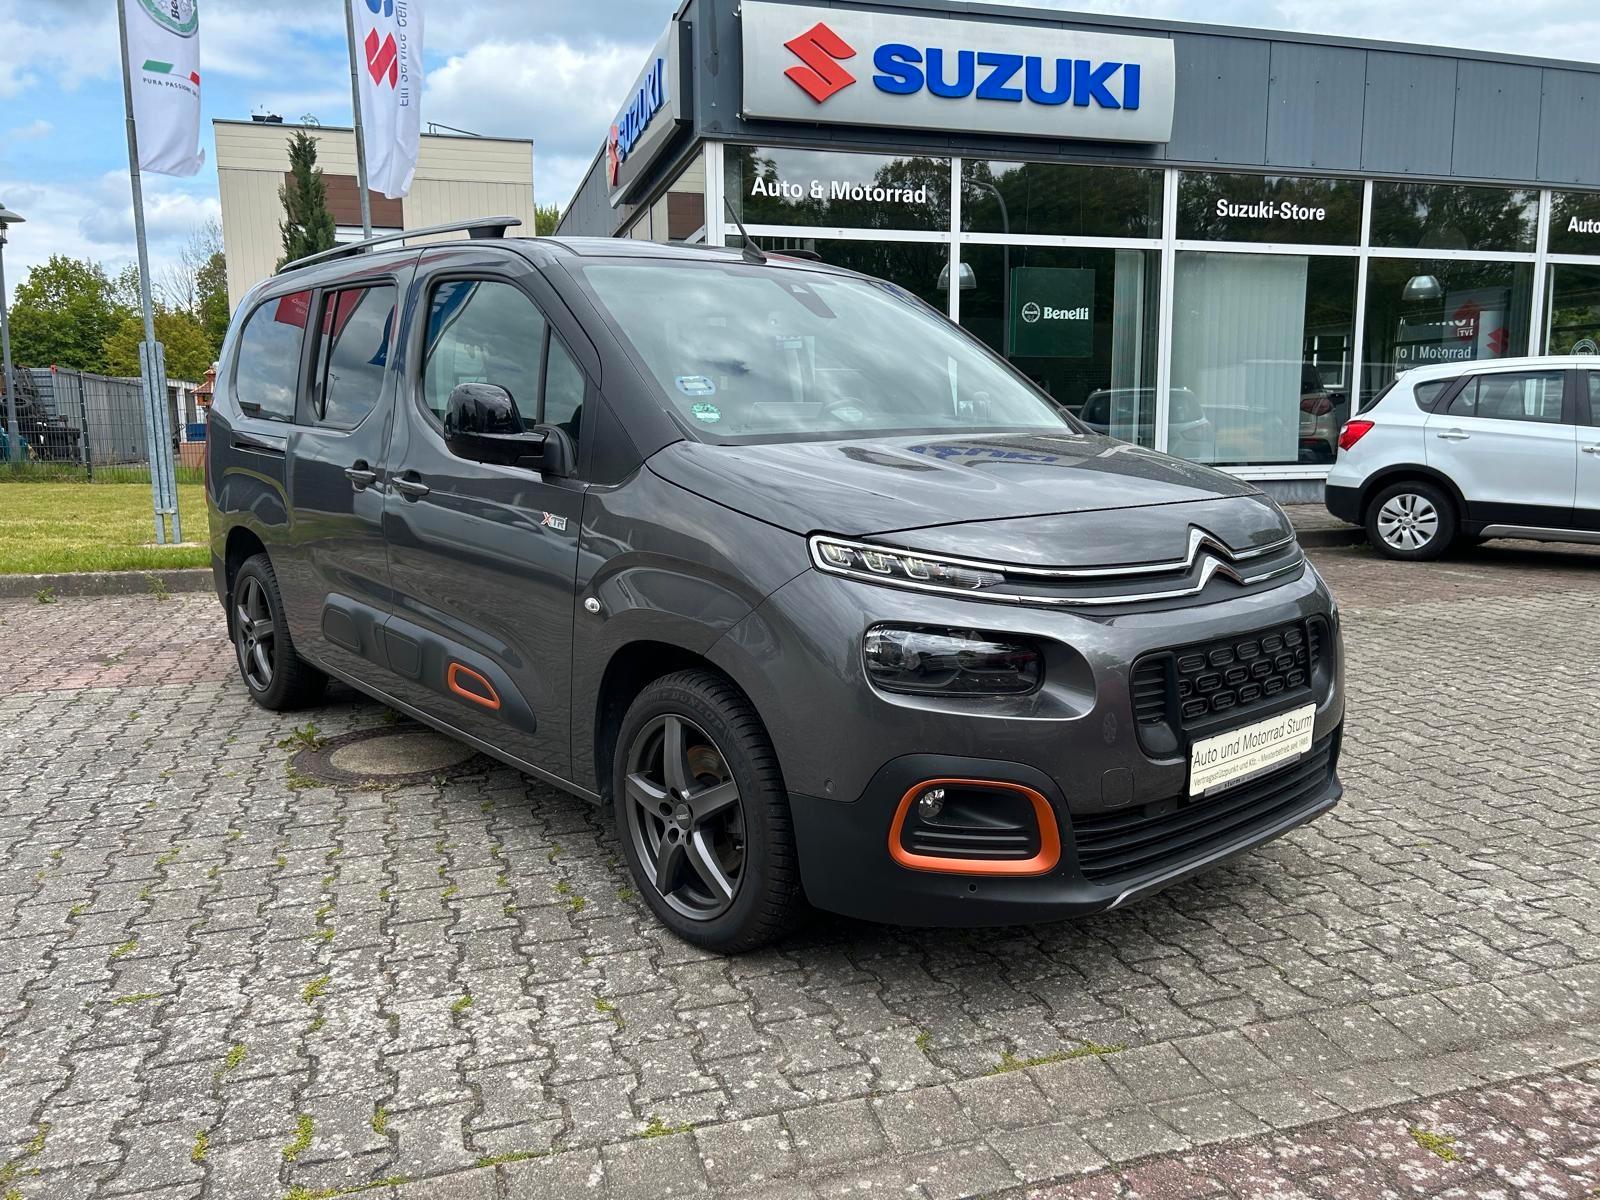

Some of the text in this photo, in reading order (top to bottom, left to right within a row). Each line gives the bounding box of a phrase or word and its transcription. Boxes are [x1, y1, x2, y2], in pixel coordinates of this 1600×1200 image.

[171, 0, 180, 20] Be
[142, 77, 162, 87] PURA
[872, 43, 1141, 110] SUZUKI
[618, 58, 665, 163] SUZUKI
[751, 176, 926, 203] Auto & Motorrad
[1216, 198, 1326, 220] Suzuki-Store
[1567, 216, 1600, 234] Auto
[1043, 306, 1089, 320] Benelli
[1419, 345, 1471, 359] Motorrad
[1193, 715, 1312, 769] Auto und Motorrad Sturm
